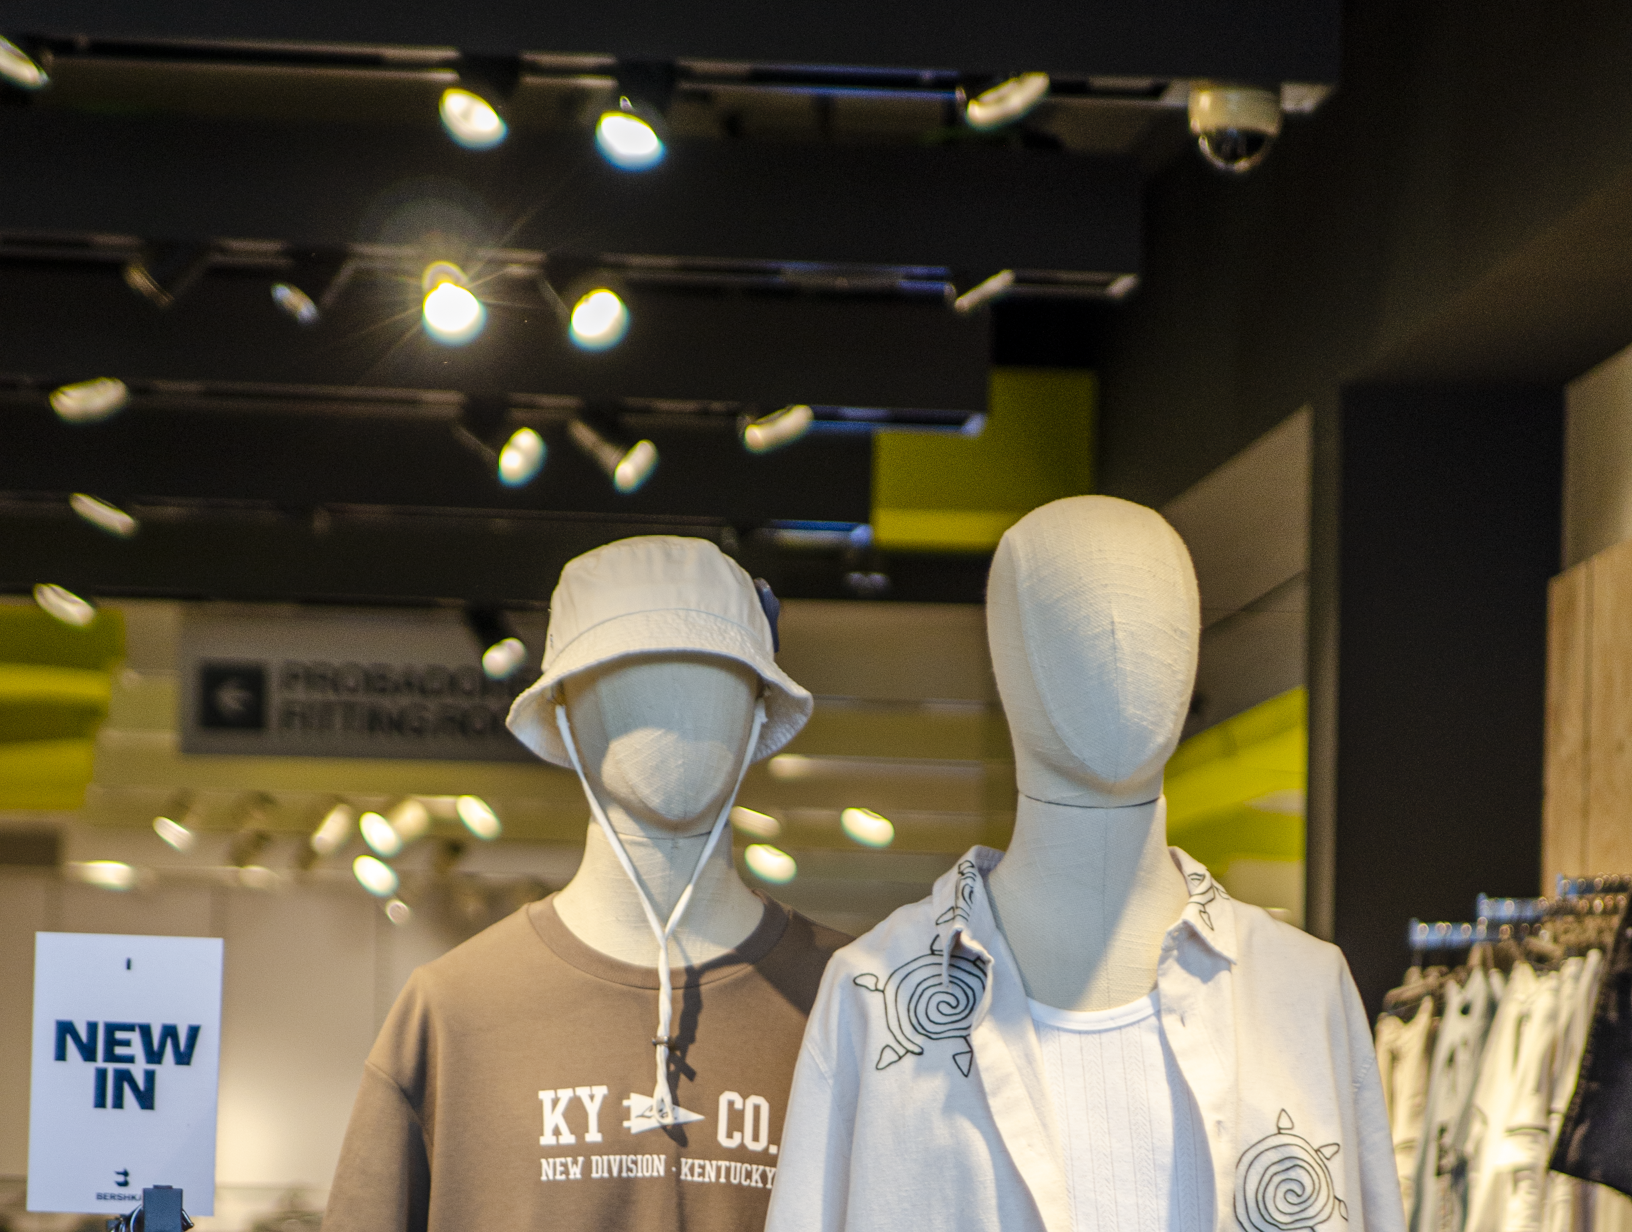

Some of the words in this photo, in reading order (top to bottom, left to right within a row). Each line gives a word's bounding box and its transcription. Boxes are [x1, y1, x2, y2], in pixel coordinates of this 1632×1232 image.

[54, 1019, 201, 1065] NEW
[93, 1066, 156, 1110] IN
[538, 1085, 608, 1145] KY
[717, 1090, 779, 1155] CO.
[540, 1156, 584, 1181] NEW
[591, 1154, 666, 1178] DIVISION
[680, 1157, 777, 1189] KENTUCKY
[96, 1192, 142, 1201] BERSHK
